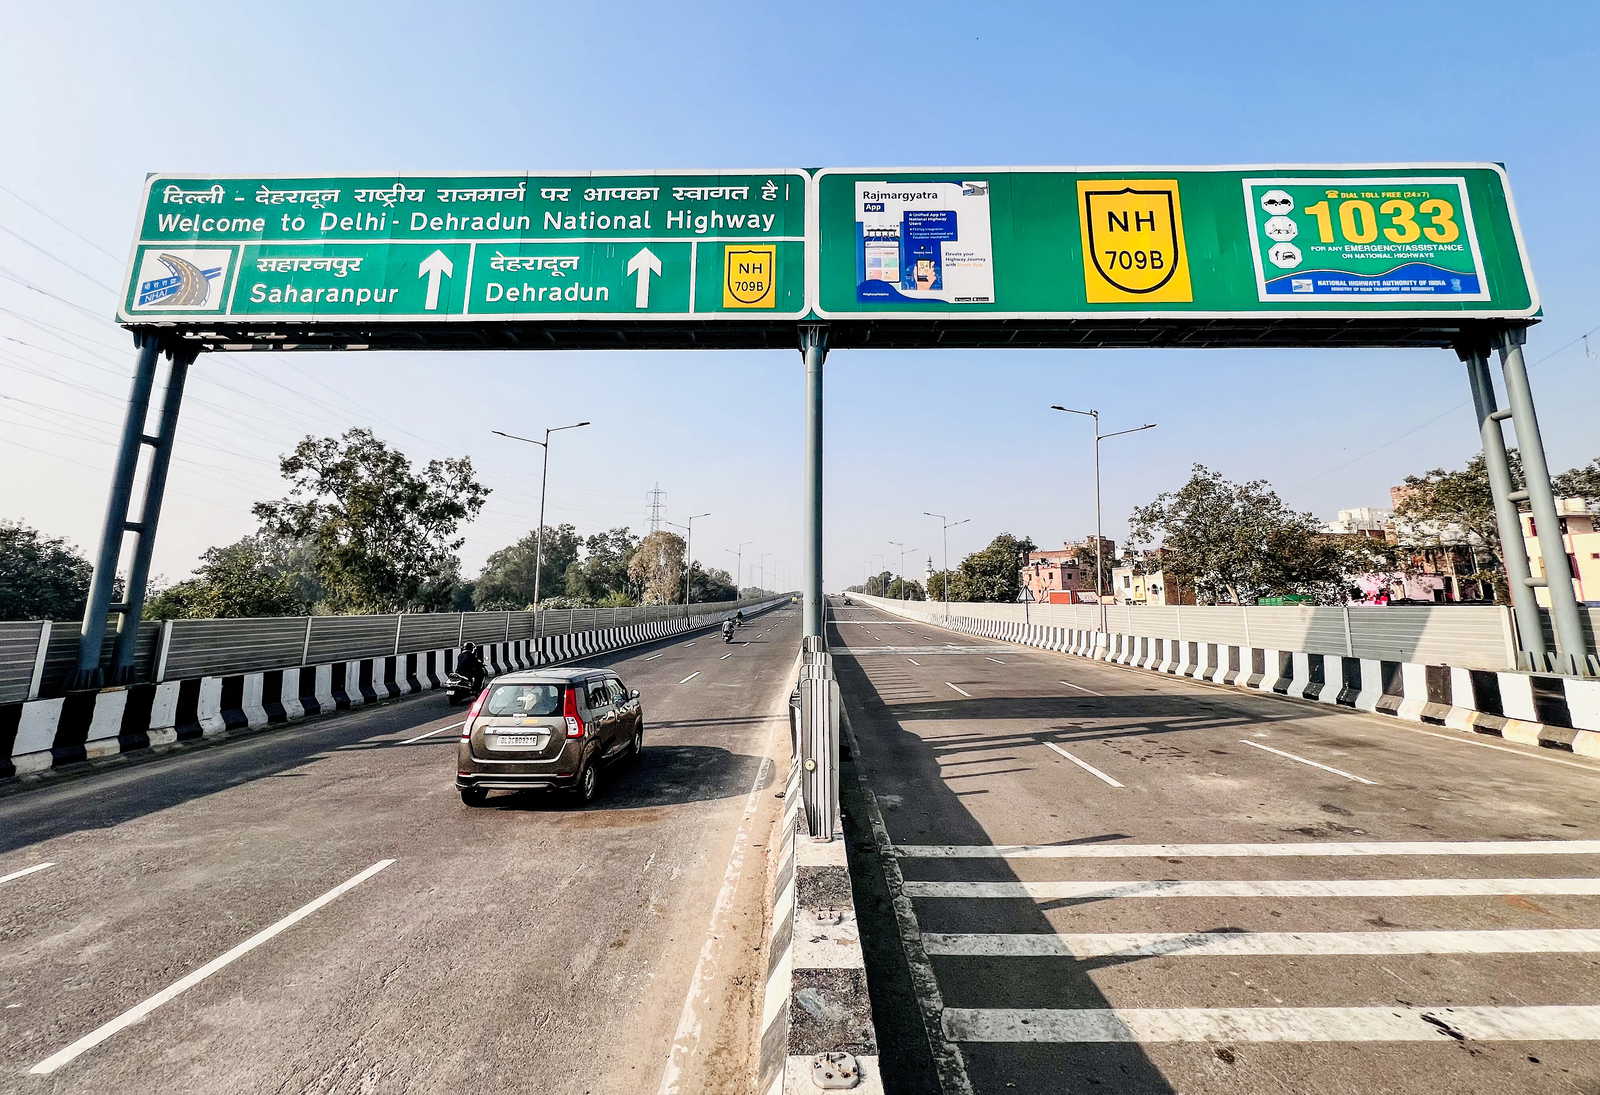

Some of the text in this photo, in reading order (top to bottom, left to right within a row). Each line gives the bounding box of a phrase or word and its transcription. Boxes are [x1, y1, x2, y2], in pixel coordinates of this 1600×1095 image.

[163, 185, 225, 205] दिल्ली
[255, 185, 340, 208] देहरादून
[354, 183, 425, 207] राष्ट्रीय
[437, 182, 527, 202] राजमार्ग
[541, 187, 571, 202] पर
[583, 186, 659, 201] आपका
[672, 186, 749, 201] स्वागत
[863, 190, 938, 201] Rajmargyatra
[865, 203, 881, 211] App
[157, 214, 266, 232] Welcome
[280, 213, 305, 231] to
[410, 212, 530, 231] Dehradun
[543, 211, 651, 230] National
[666, 210, 776, 234] Highway
[1108, 211, 1155, 232] NH
[1304, 199, 1460, 244] 1033
[256, 257, 364, 277] सहारनपुर
[490, 252, 580, 276] देहरादून
[738, 263, 763, 274] NH
[1105, 250, 1164, 270] 709B
[144, 289, 168, 303] NHAI
[250, 284, 399, 307] Saharanpur
[486, 282, 609, 303] Dehradun
[735, 281, 764, 292] 709B
